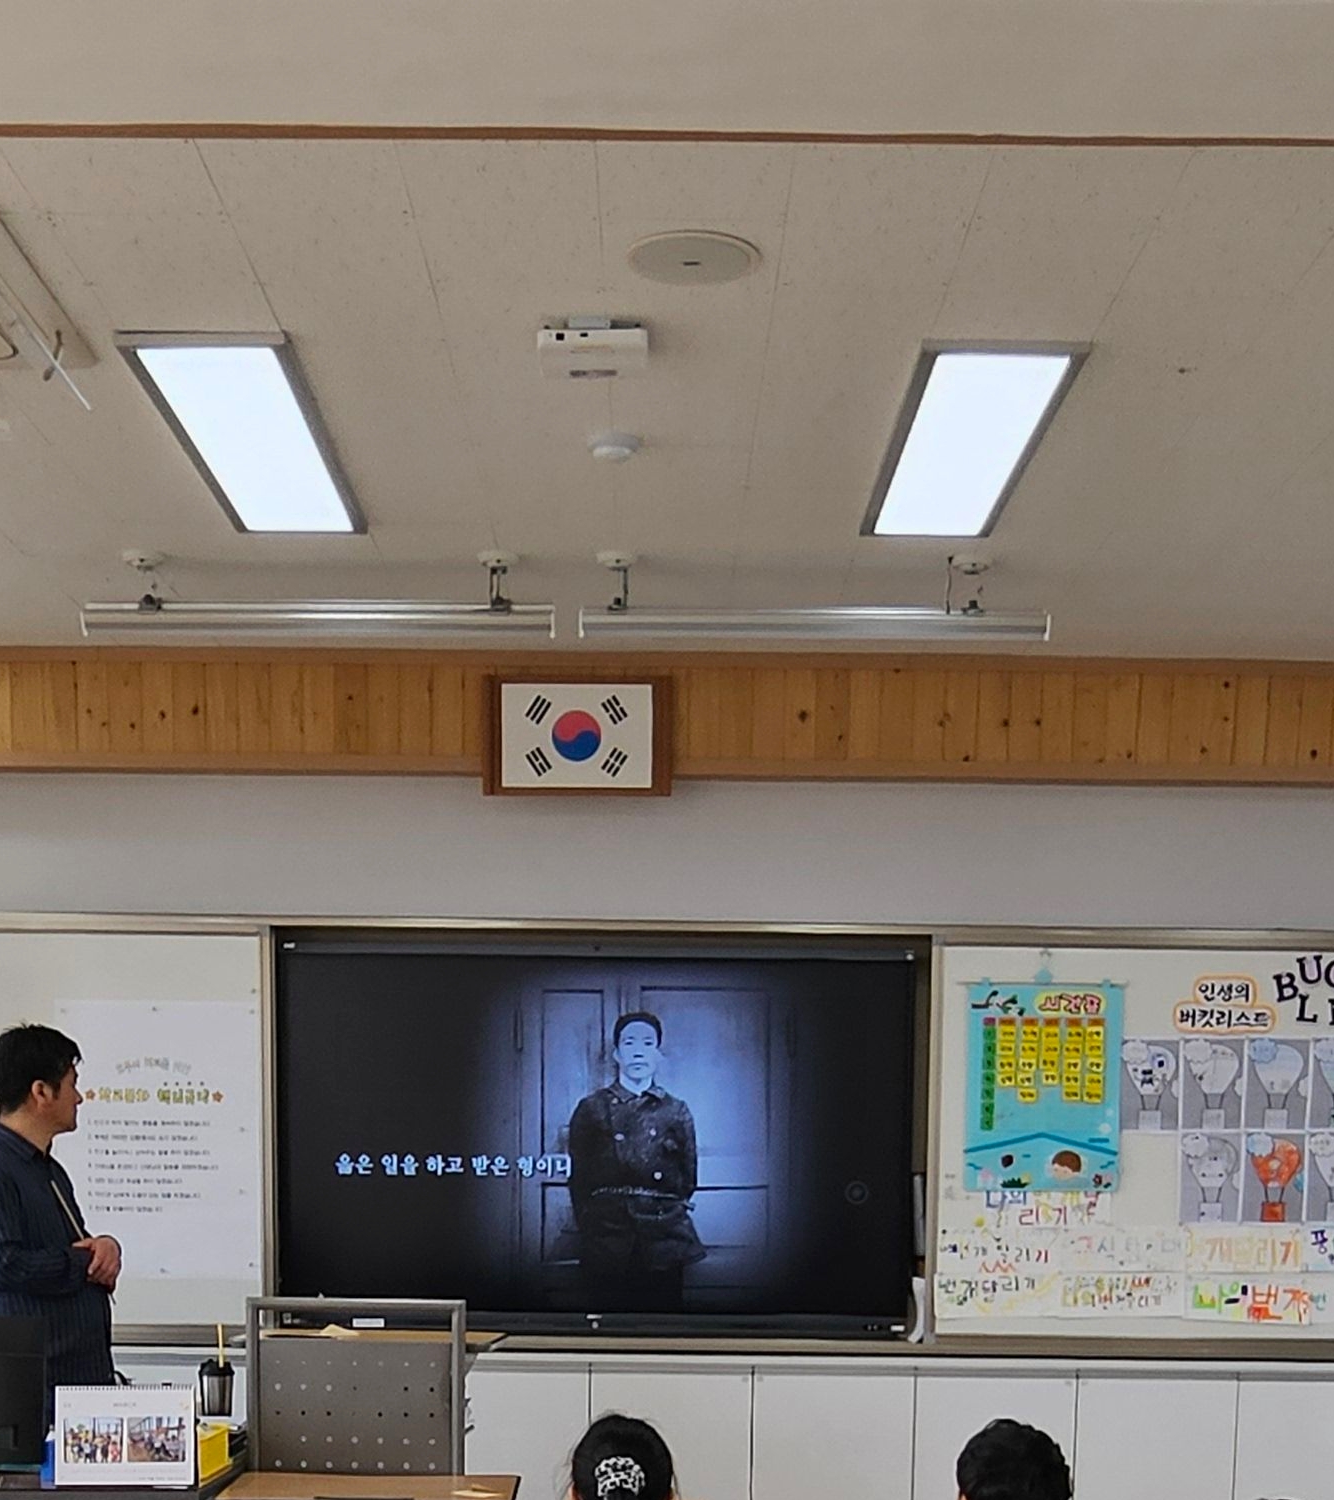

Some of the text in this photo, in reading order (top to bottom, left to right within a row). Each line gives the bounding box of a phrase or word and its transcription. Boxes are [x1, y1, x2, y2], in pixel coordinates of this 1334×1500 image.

[1037, 992, 1103, 1015] 시간표
[1197, 982, 1251, 1003] 인생의
[1178, 1007, 1272, 1030] 버킷리스트
[380, 1153, 419, 1176] 일을
[425, 1153, 464, 1177] 하고
[471, 1154, 510, 1177] 받은
